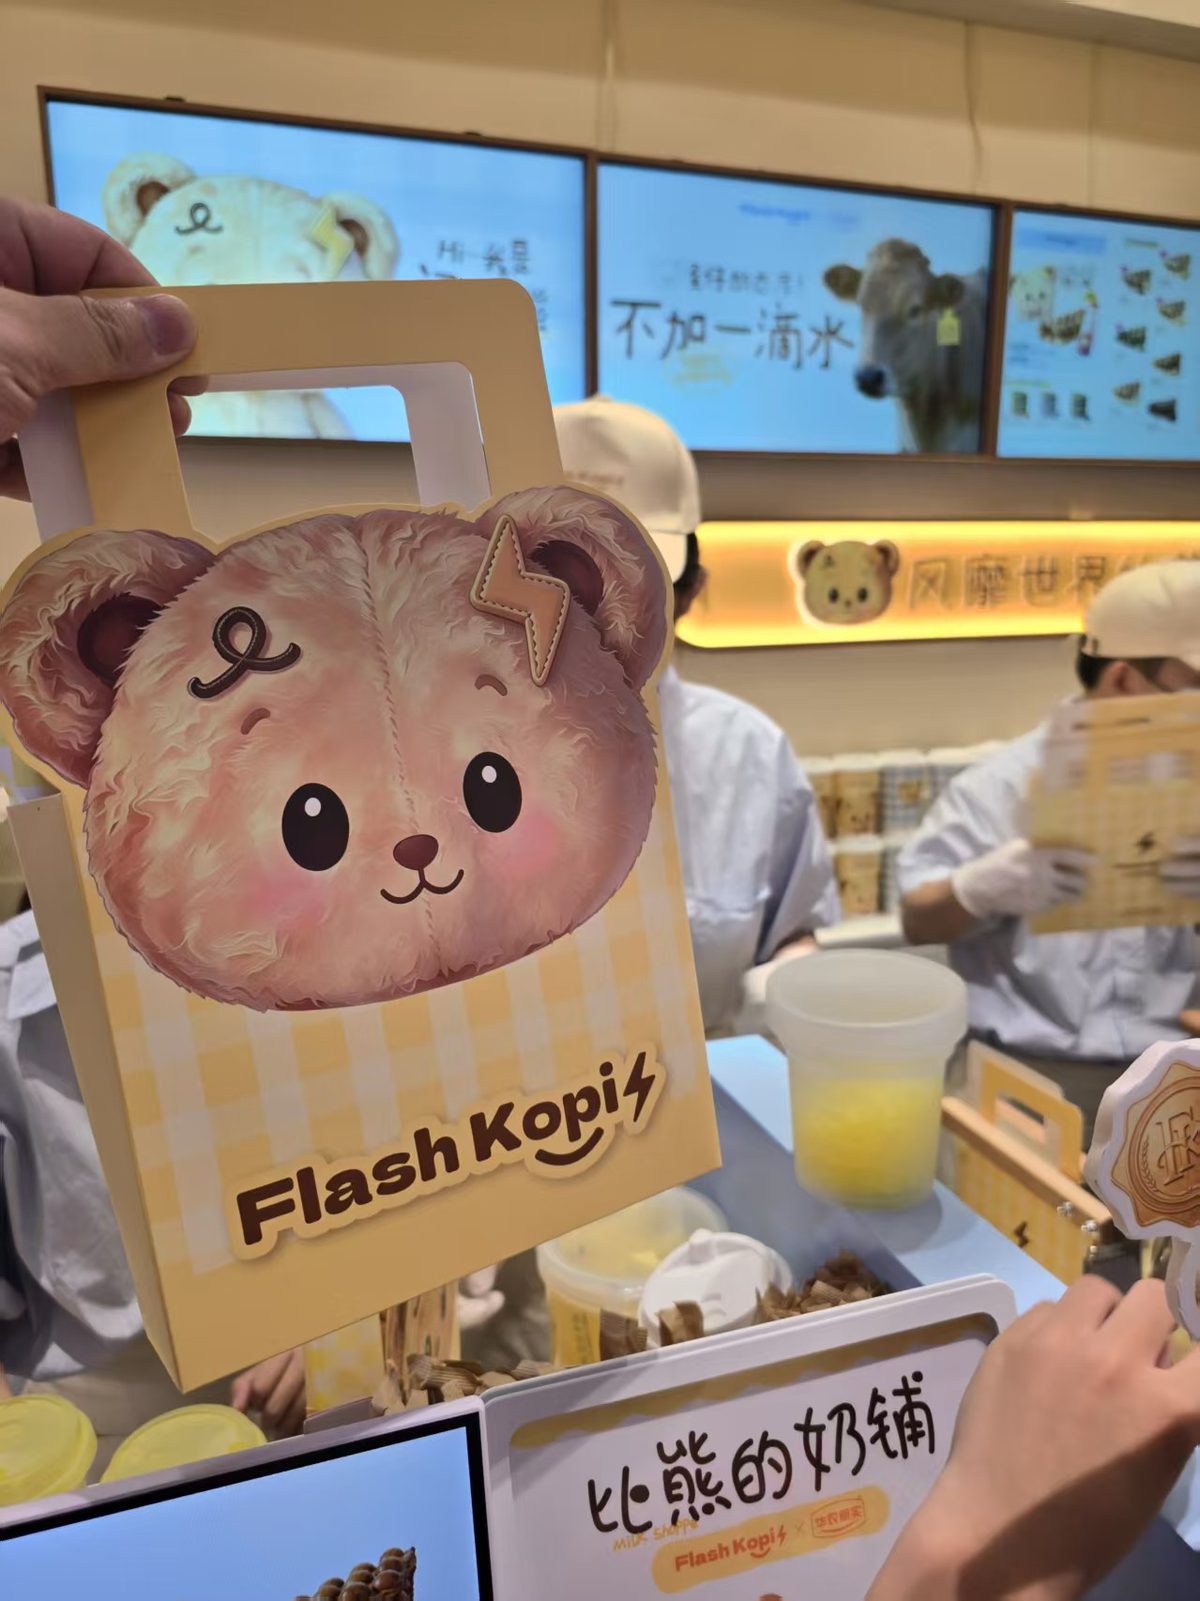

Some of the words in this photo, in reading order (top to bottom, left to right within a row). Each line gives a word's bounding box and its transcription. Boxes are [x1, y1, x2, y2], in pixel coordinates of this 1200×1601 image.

[609, 298, 855, 370] 不加一滴水
[236, 1127, 461, 1246] Flash
[469, 1061, 620, 1162] Kopi
[587, 1370, 936, 1535] 比熊的奶铺
[674, 1543, 731, 1572] Flash
[732, 1527, 777, 1556] Kopi
